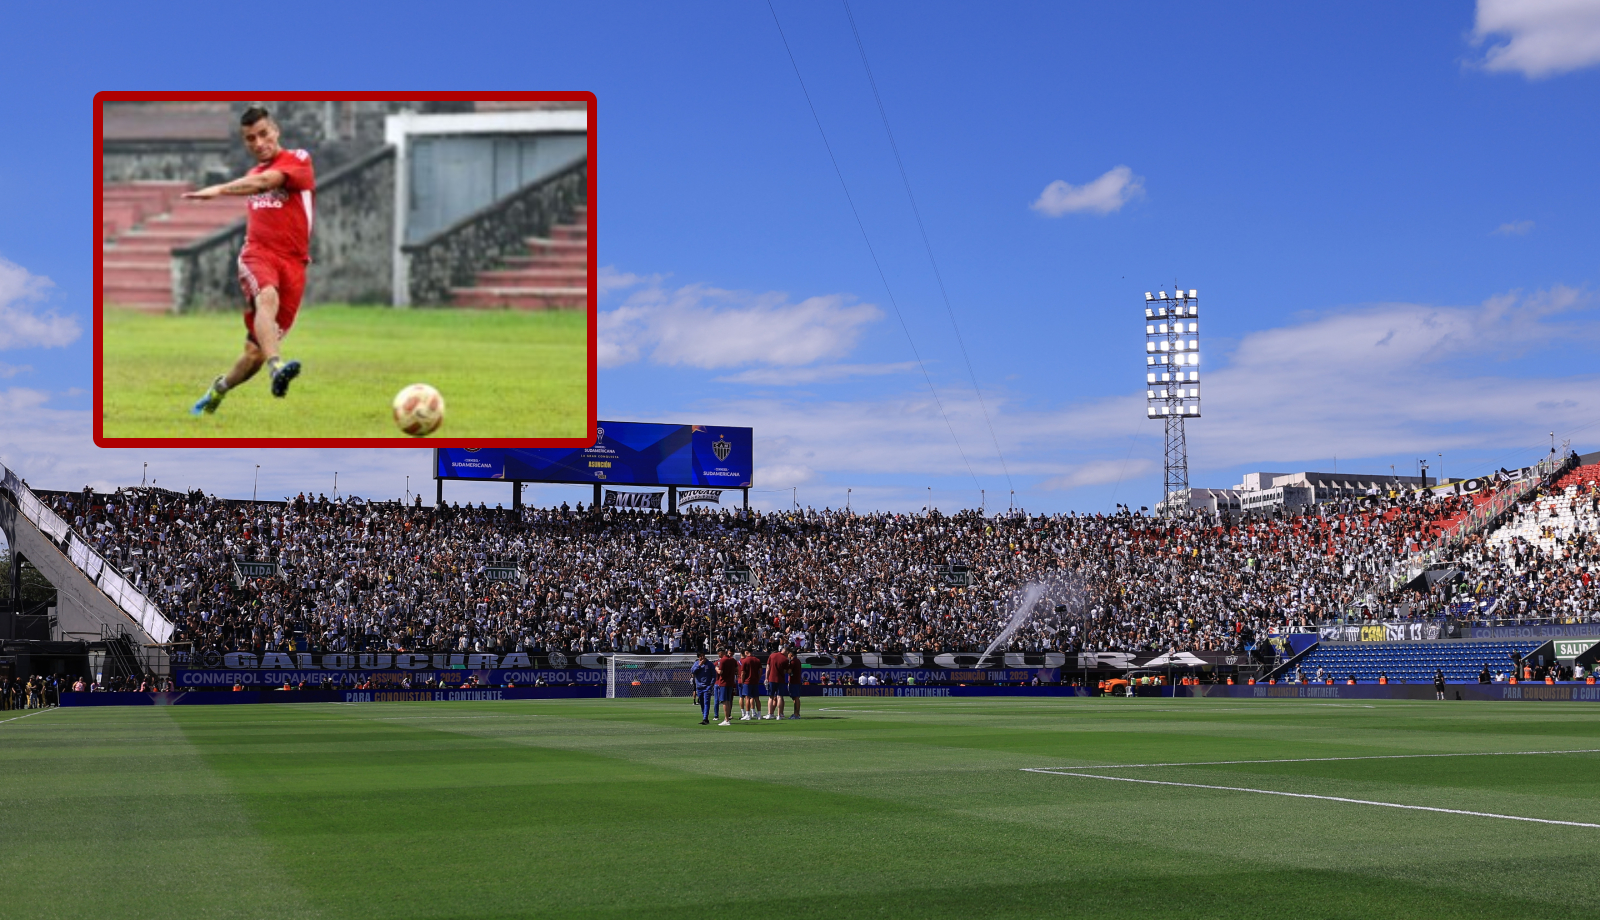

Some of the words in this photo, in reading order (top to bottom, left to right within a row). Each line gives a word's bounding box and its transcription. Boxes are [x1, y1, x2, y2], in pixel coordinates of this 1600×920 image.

[487, 571, 514, 580] ALIDA
[1410, 623, 1422, 640] 13
[1476, 627, 1537, 638] CONMEBOL
[223, 652, 532, 669] GALOUCURA
[183, 672, 261, 684] CONMEBOL
[264, 672, 366, 684] SUDAMERICANA
[415, 673, 436, 683] FINAL
[440, 672, 461, 683] 2025
[503, 671, 572, 683] CONMEBOL
[801, 671, 856, 681] ONMEBOL
[950, 669, 986, 682] ASSUNÇÃO
[988, 670, 1007, 681] FINAL
[1009, 670, 1028, 680] 2025
[346, 692, 371, 702] PARA
[374, 691, 431, 702] CONQUISTAR
[435, 691, 445, 701] EL
[822, 687, 843, 697] PARA
[846, 687, 895, 697] CONQUISTAR
[1253, 687, 1267, 697] PARA
[1300, 687, 1306, 697] EL
[1503, 687, 1522, 699] PARA
[1524, 687, 1570, 699] CONQUISTAR
[1572, 687, 1578, 699] O
